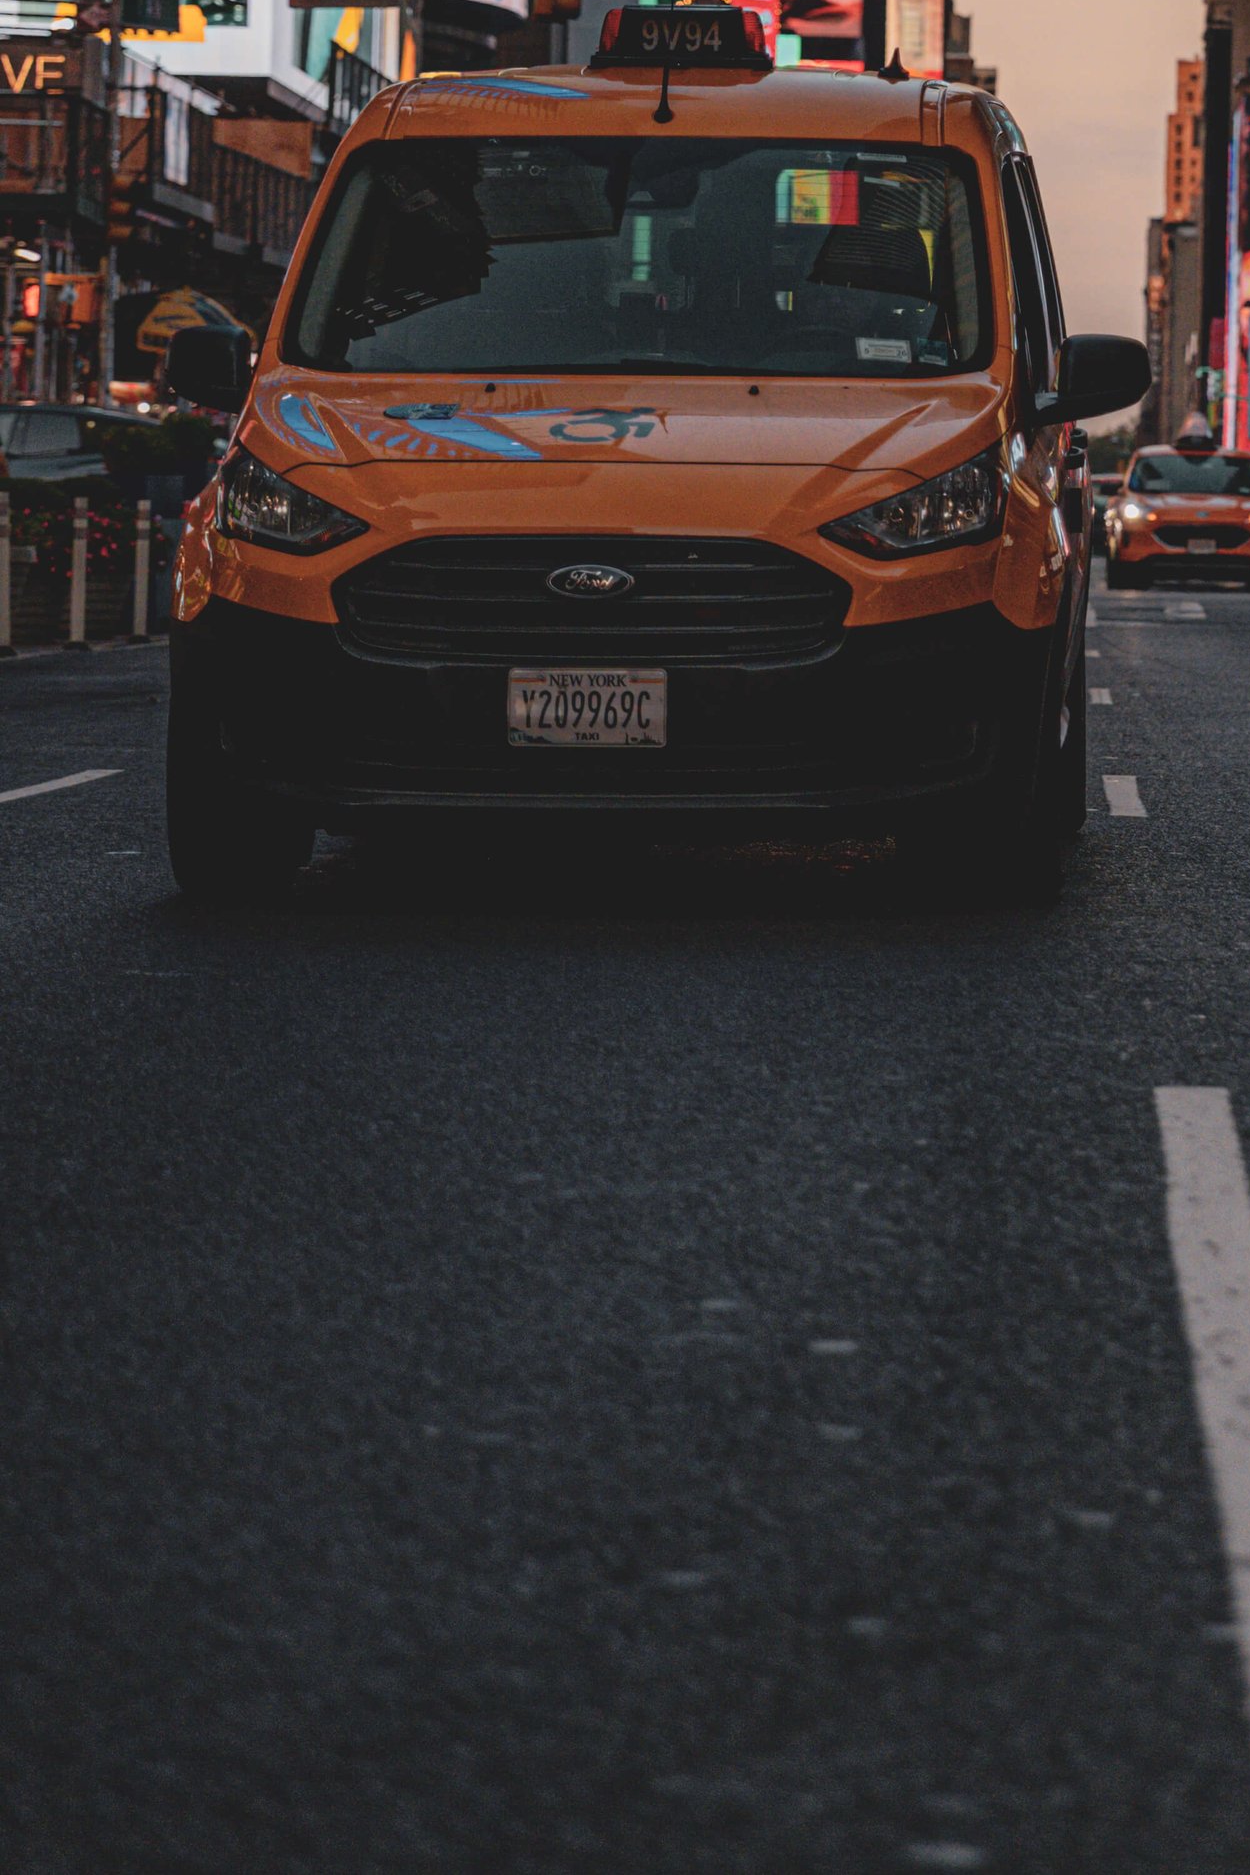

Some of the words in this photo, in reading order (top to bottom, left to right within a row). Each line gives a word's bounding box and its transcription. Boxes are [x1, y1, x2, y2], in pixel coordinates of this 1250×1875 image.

[641, 18, 723, 52] 9V94
[565, 569, 614, 591] Ford
[549, 674, 586, 688] NEW
[588, 674, 627, 688] YORK
[522, 690, 651, 730] Y209969C
[575, 732, 600, 742] TAXI
